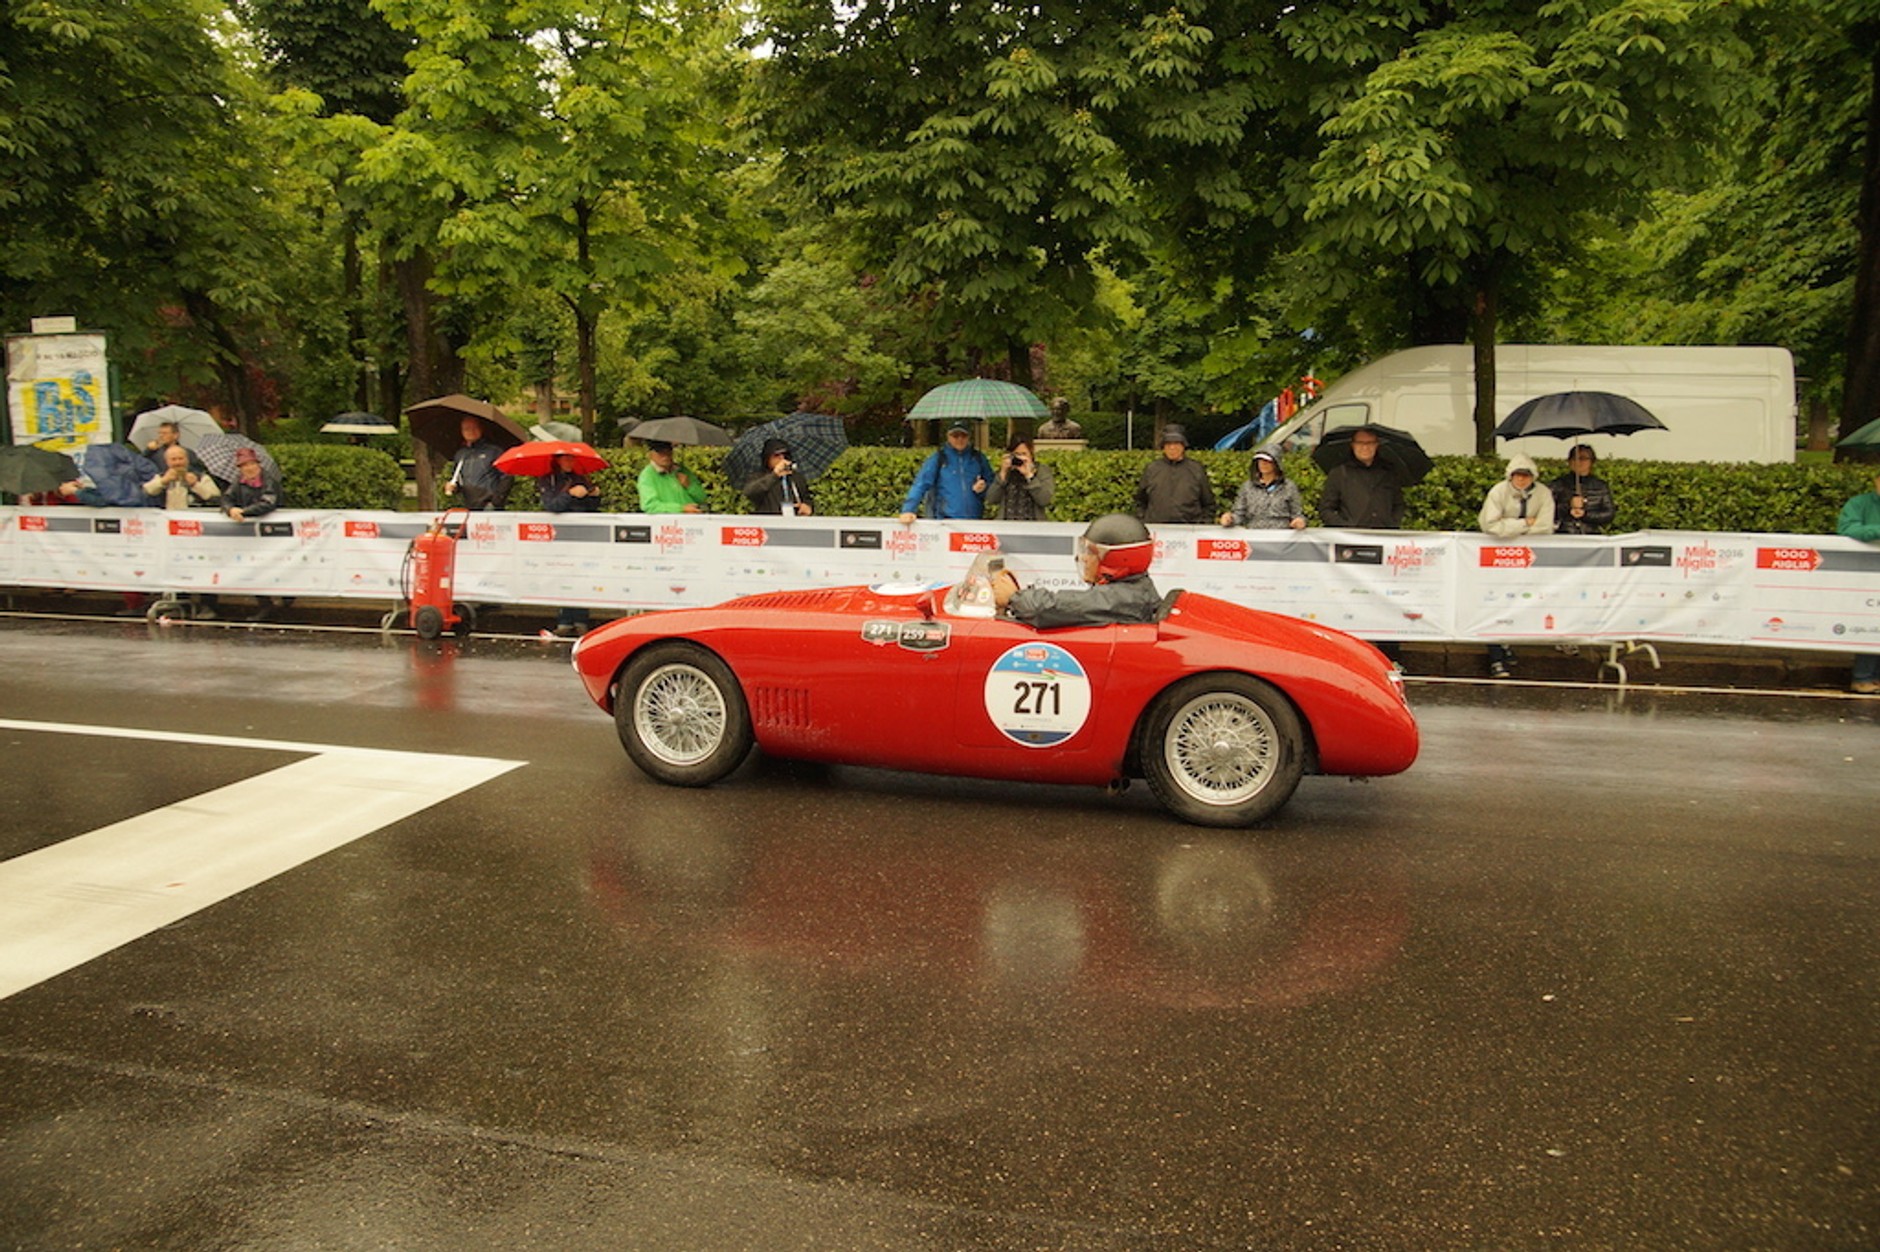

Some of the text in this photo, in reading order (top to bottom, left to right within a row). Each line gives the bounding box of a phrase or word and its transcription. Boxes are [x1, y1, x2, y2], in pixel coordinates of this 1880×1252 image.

[963, 534, 990, 543] 1000
[1212, 541, 1240, 550] 1000
[1210, 550, 1242, 559] MIGLIA
[1495, 549, 1524, 557] 1000
[1774, 550, 1809, 559] 1000
[1771, 560, 1811, 569] MIGLIA
[1035, 578, 1087, 587] CHOPAR
[870, 624, 892, 635] 271
[903, 629, 925, 640] 259
[1014, 681, 1060, 716] 271
